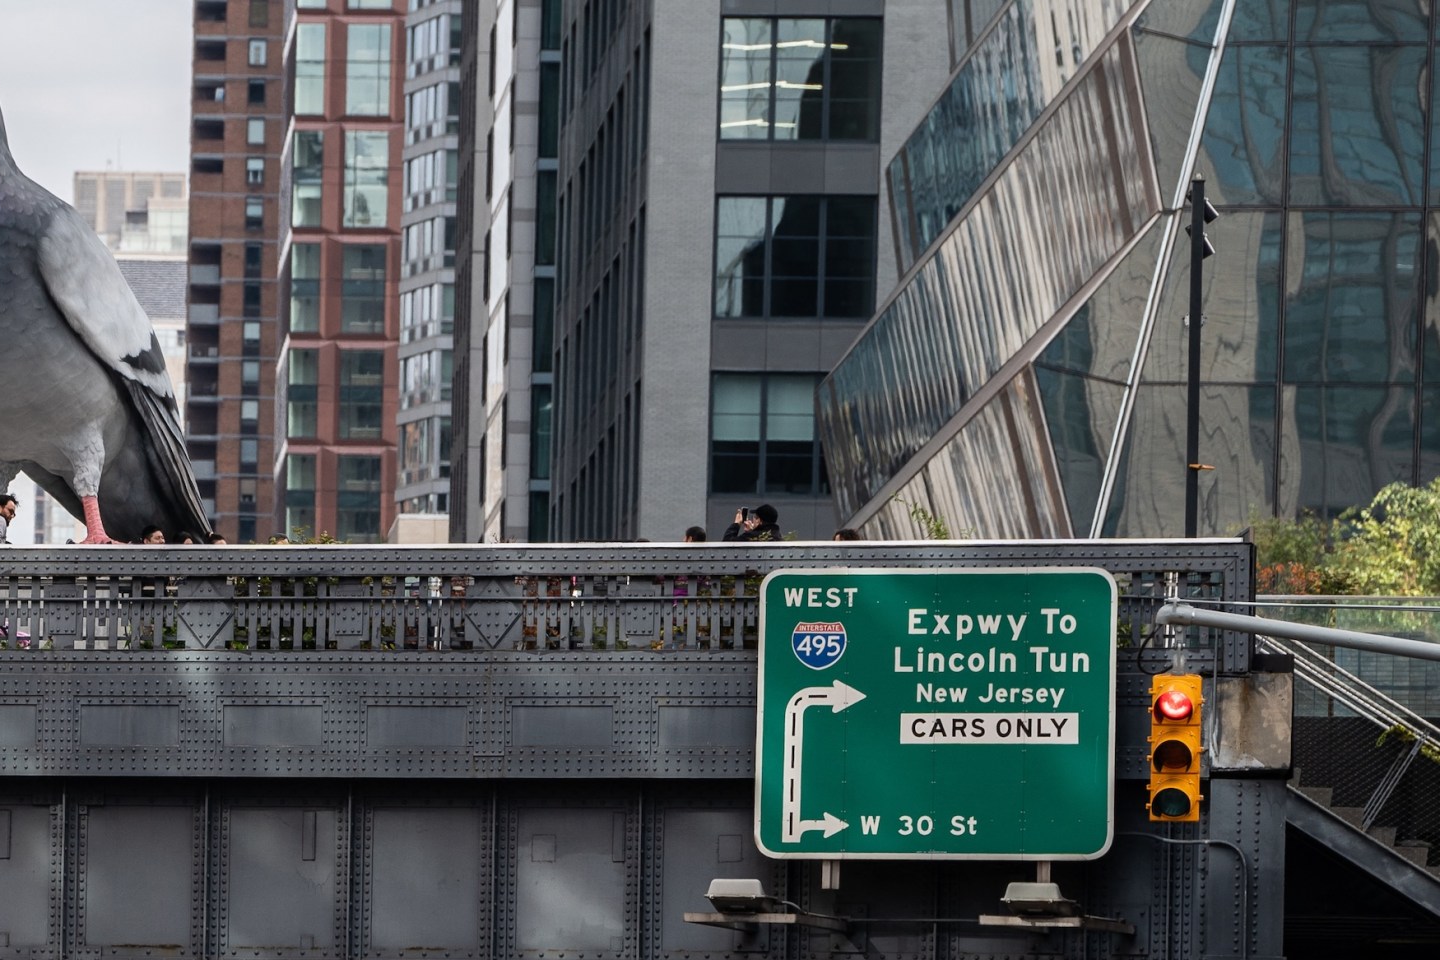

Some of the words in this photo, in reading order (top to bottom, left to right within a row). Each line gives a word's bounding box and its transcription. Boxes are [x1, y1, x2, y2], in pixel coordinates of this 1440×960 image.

[783, 587, 858, 608] WEST
[799, 624, 840, 632] INTERSTATE
[908, 608, 1028, 641] Expwy
[1041, 608, 1077, 635] To
[796, 634, 841, 657] 495
[894, 647, 1017, 673] Lincoln
[1029, 647, 1090, 673] Tun
[916, 683, 968, 703] New
[978, 683, 1065, 708] Jersey
[911, 718, 986, 739] CARS
[996, 718, 1068, 738] ONLY
[860, 816, 881, 835] W
[897, 816, 934, 835] 30
[949, 816, 978, 836] St
